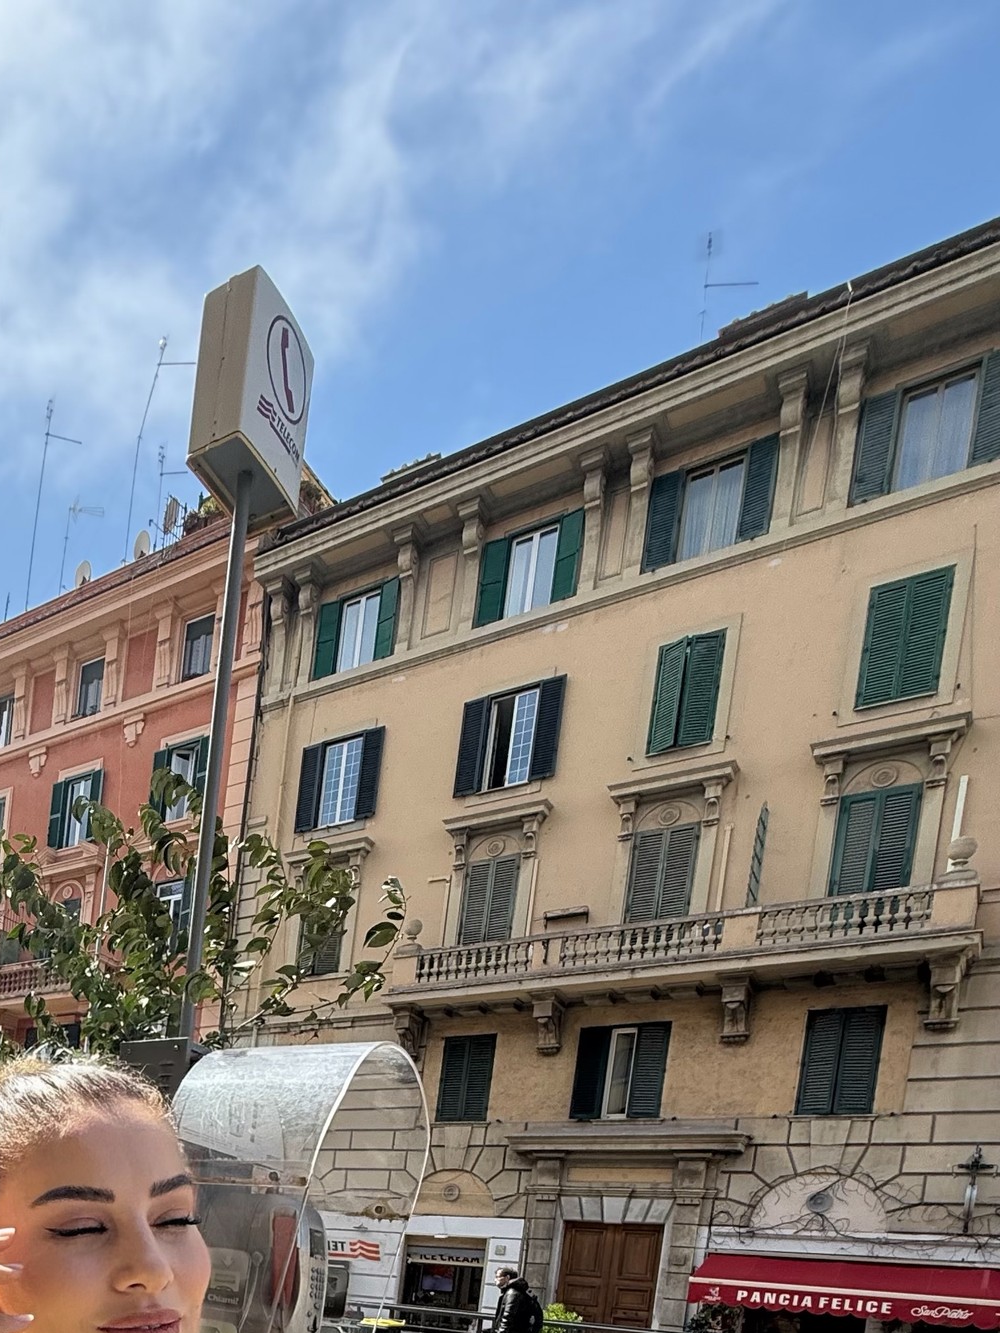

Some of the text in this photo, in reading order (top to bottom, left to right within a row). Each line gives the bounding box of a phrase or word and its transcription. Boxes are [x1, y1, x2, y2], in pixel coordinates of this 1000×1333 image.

[276, 416, 300, 462] TELECOM
[207, 1293, 239, 1305] Chiami?
[736, 1290, 893, 1315] PANCIA FELICE
